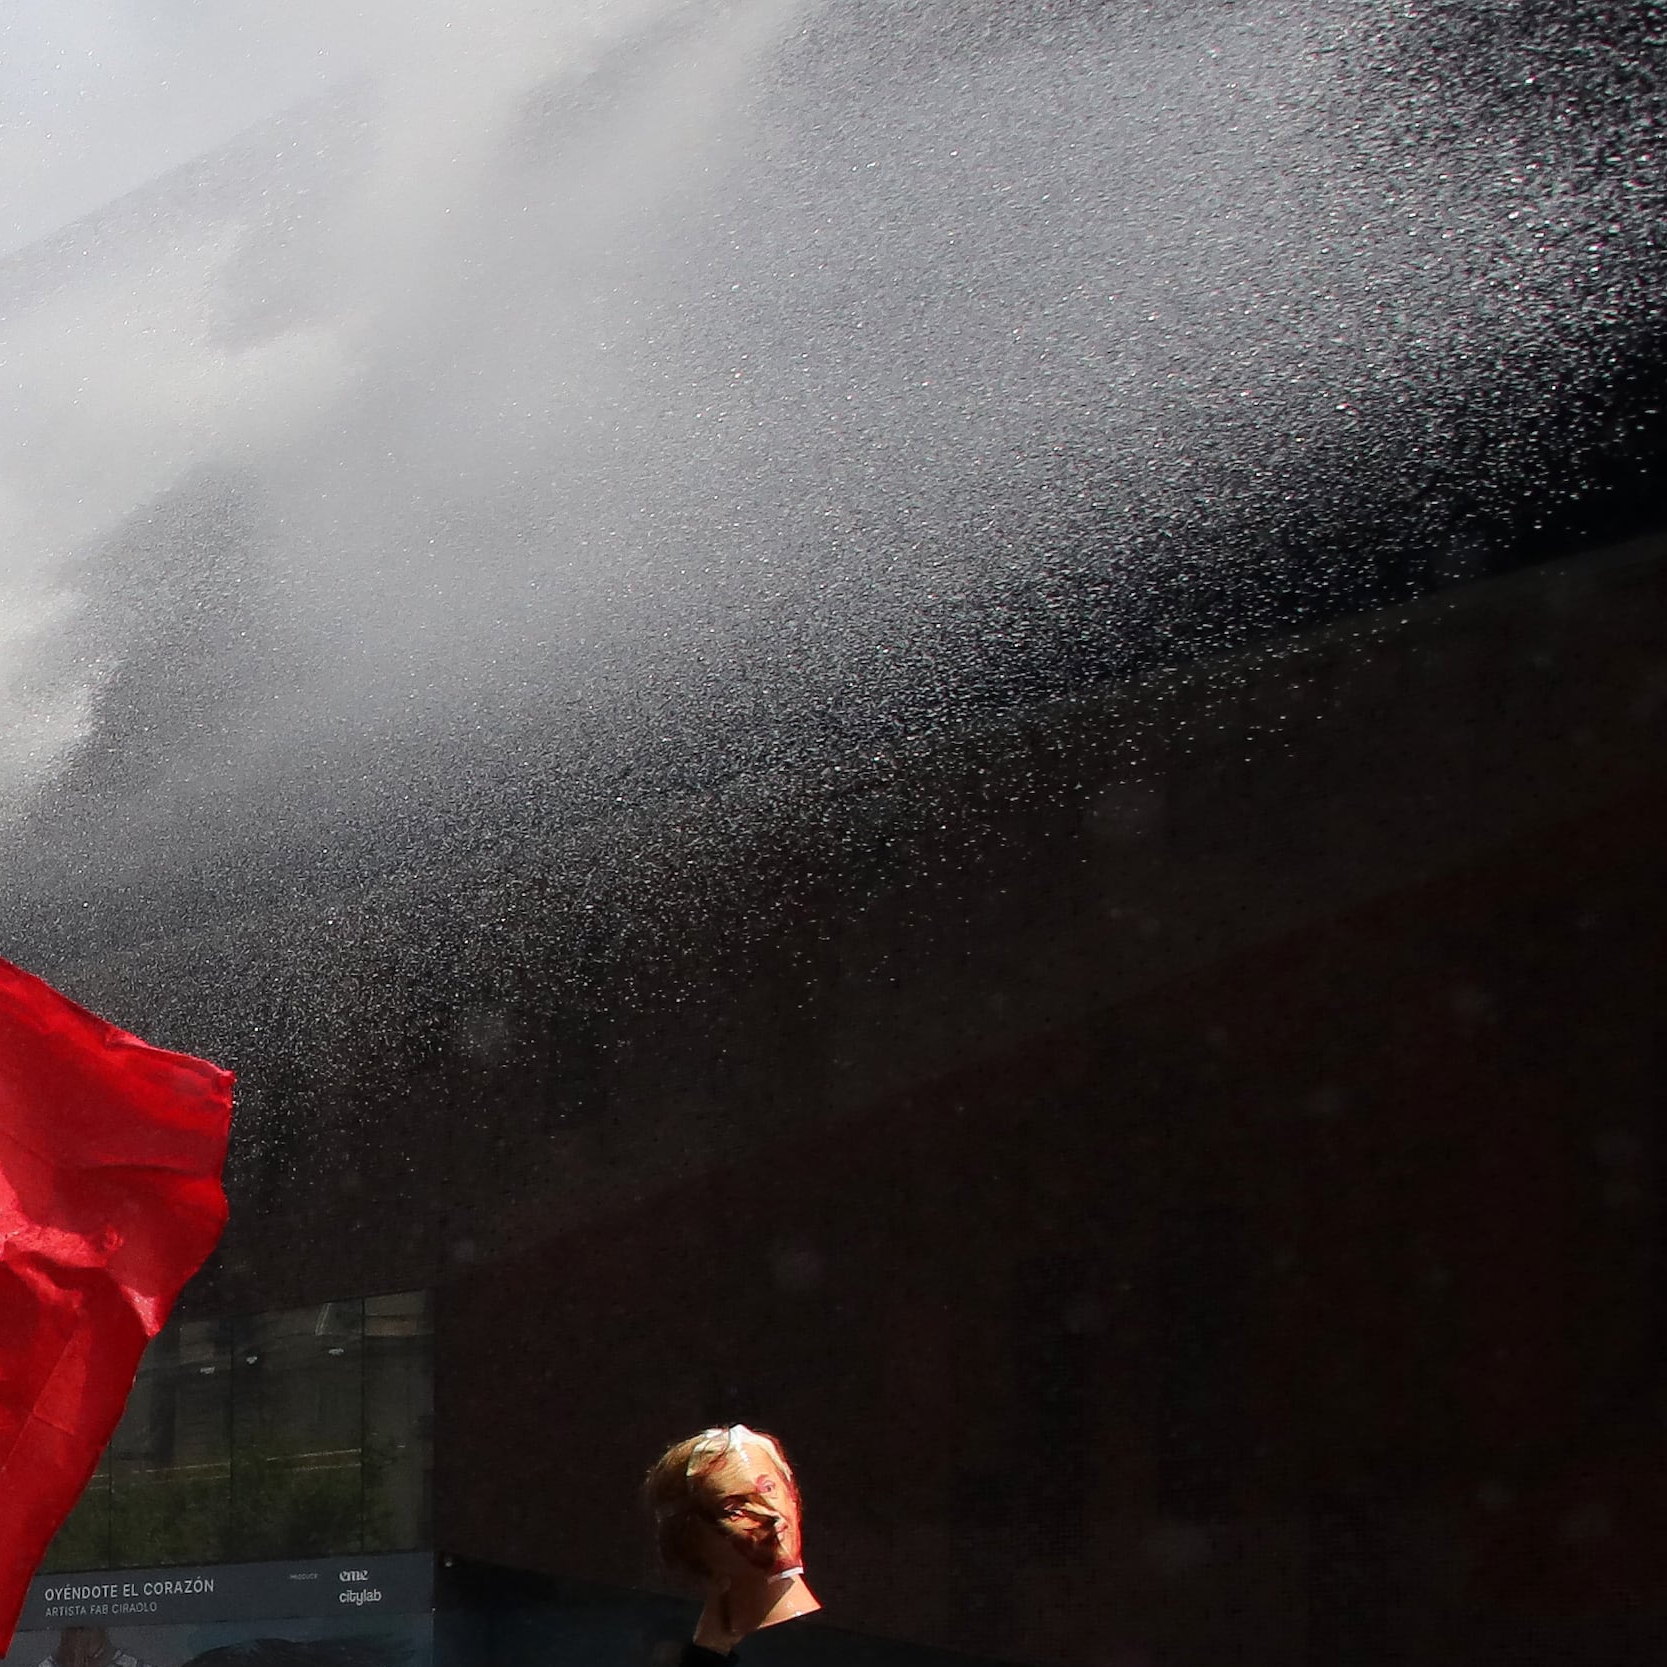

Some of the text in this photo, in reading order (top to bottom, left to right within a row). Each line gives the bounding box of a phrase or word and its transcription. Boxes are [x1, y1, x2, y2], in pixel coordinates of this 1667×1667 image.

[44, 1576, 215, 1601] OYÉNDOTE EL CORAZÓN
[339, 1588, 382, 1606] citylab
[45, 1605, 87, 1618] ARTISTA
[90, 1604, 109, 1616] FAB
